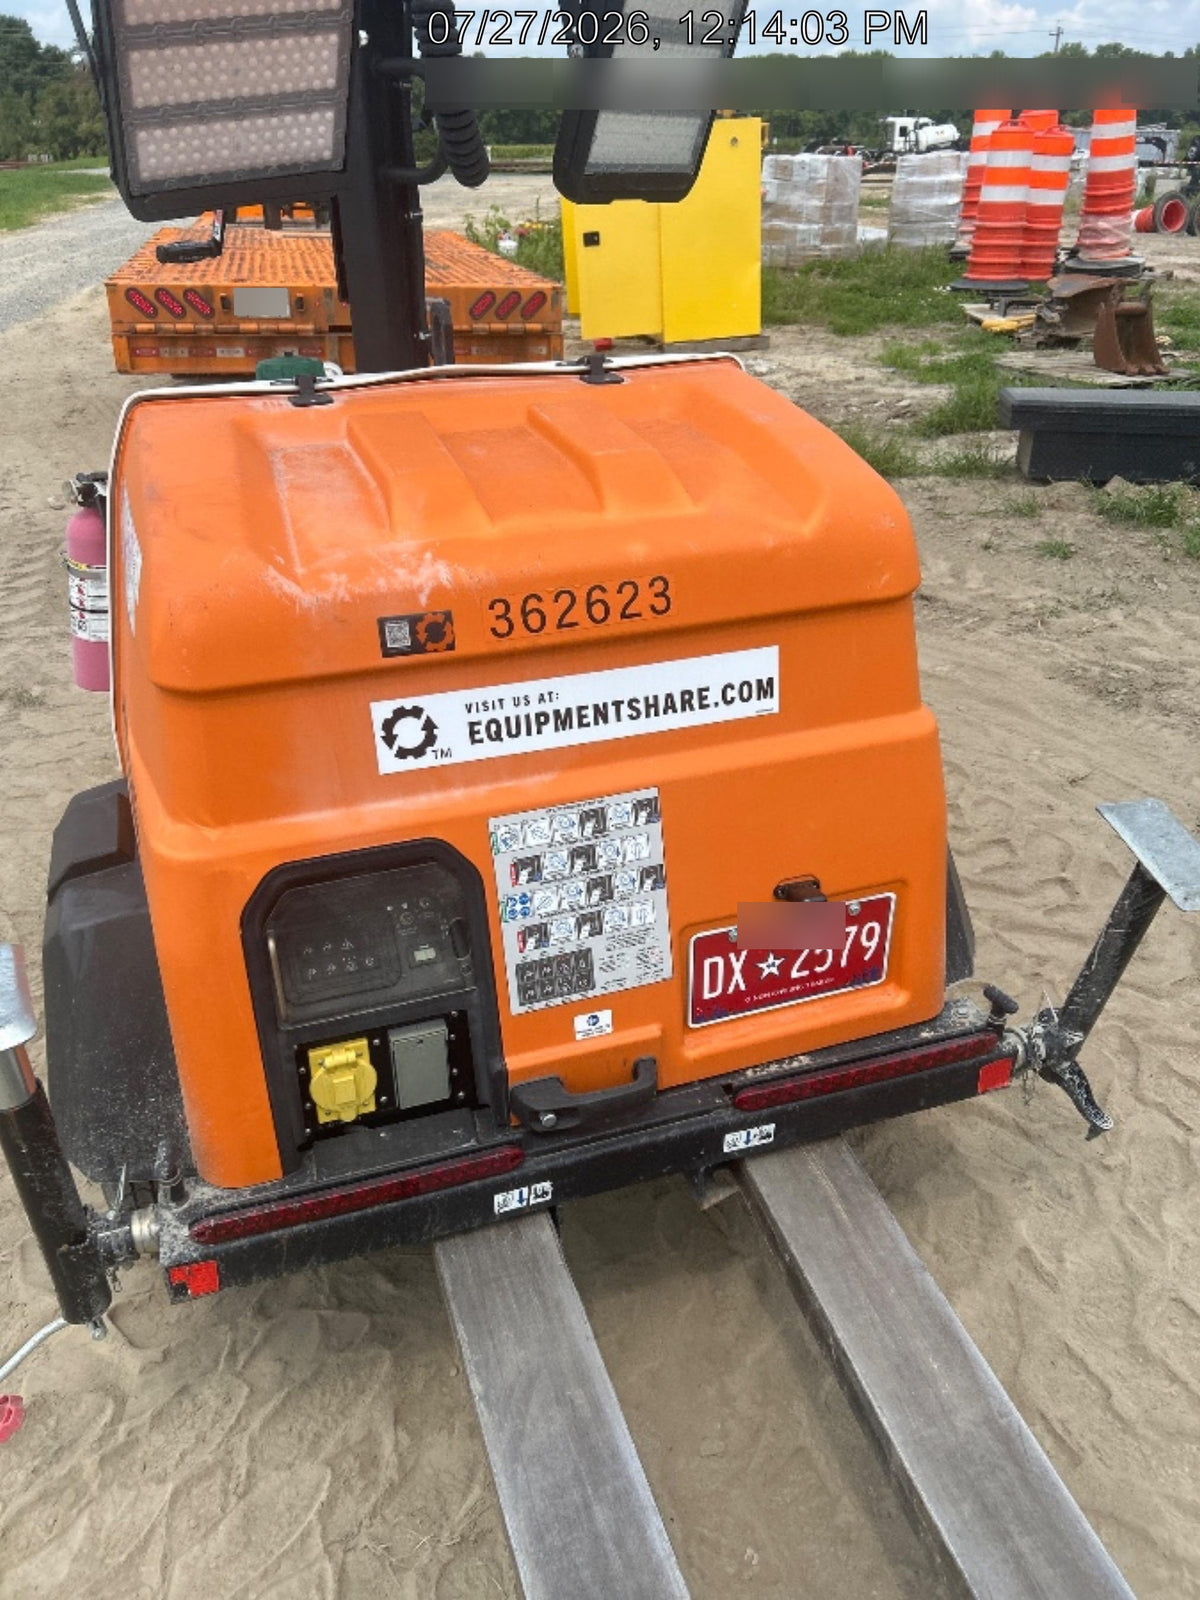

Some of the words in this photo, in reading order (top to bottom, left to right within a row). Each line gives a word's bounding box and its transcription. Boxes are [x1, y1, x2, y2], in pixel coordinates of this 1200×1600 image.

[487, 575, 673, 639] 362623
[464, 697, 504, 715] VISIT
[512, 695, 531, 708] US
[538, 691, 560, 704] AT:
[467, 676, 775, 746] EQUIPMENTSHARE.COM
[431, 747, 452, 760] TM
[702, 949, 748, 1000] DX
